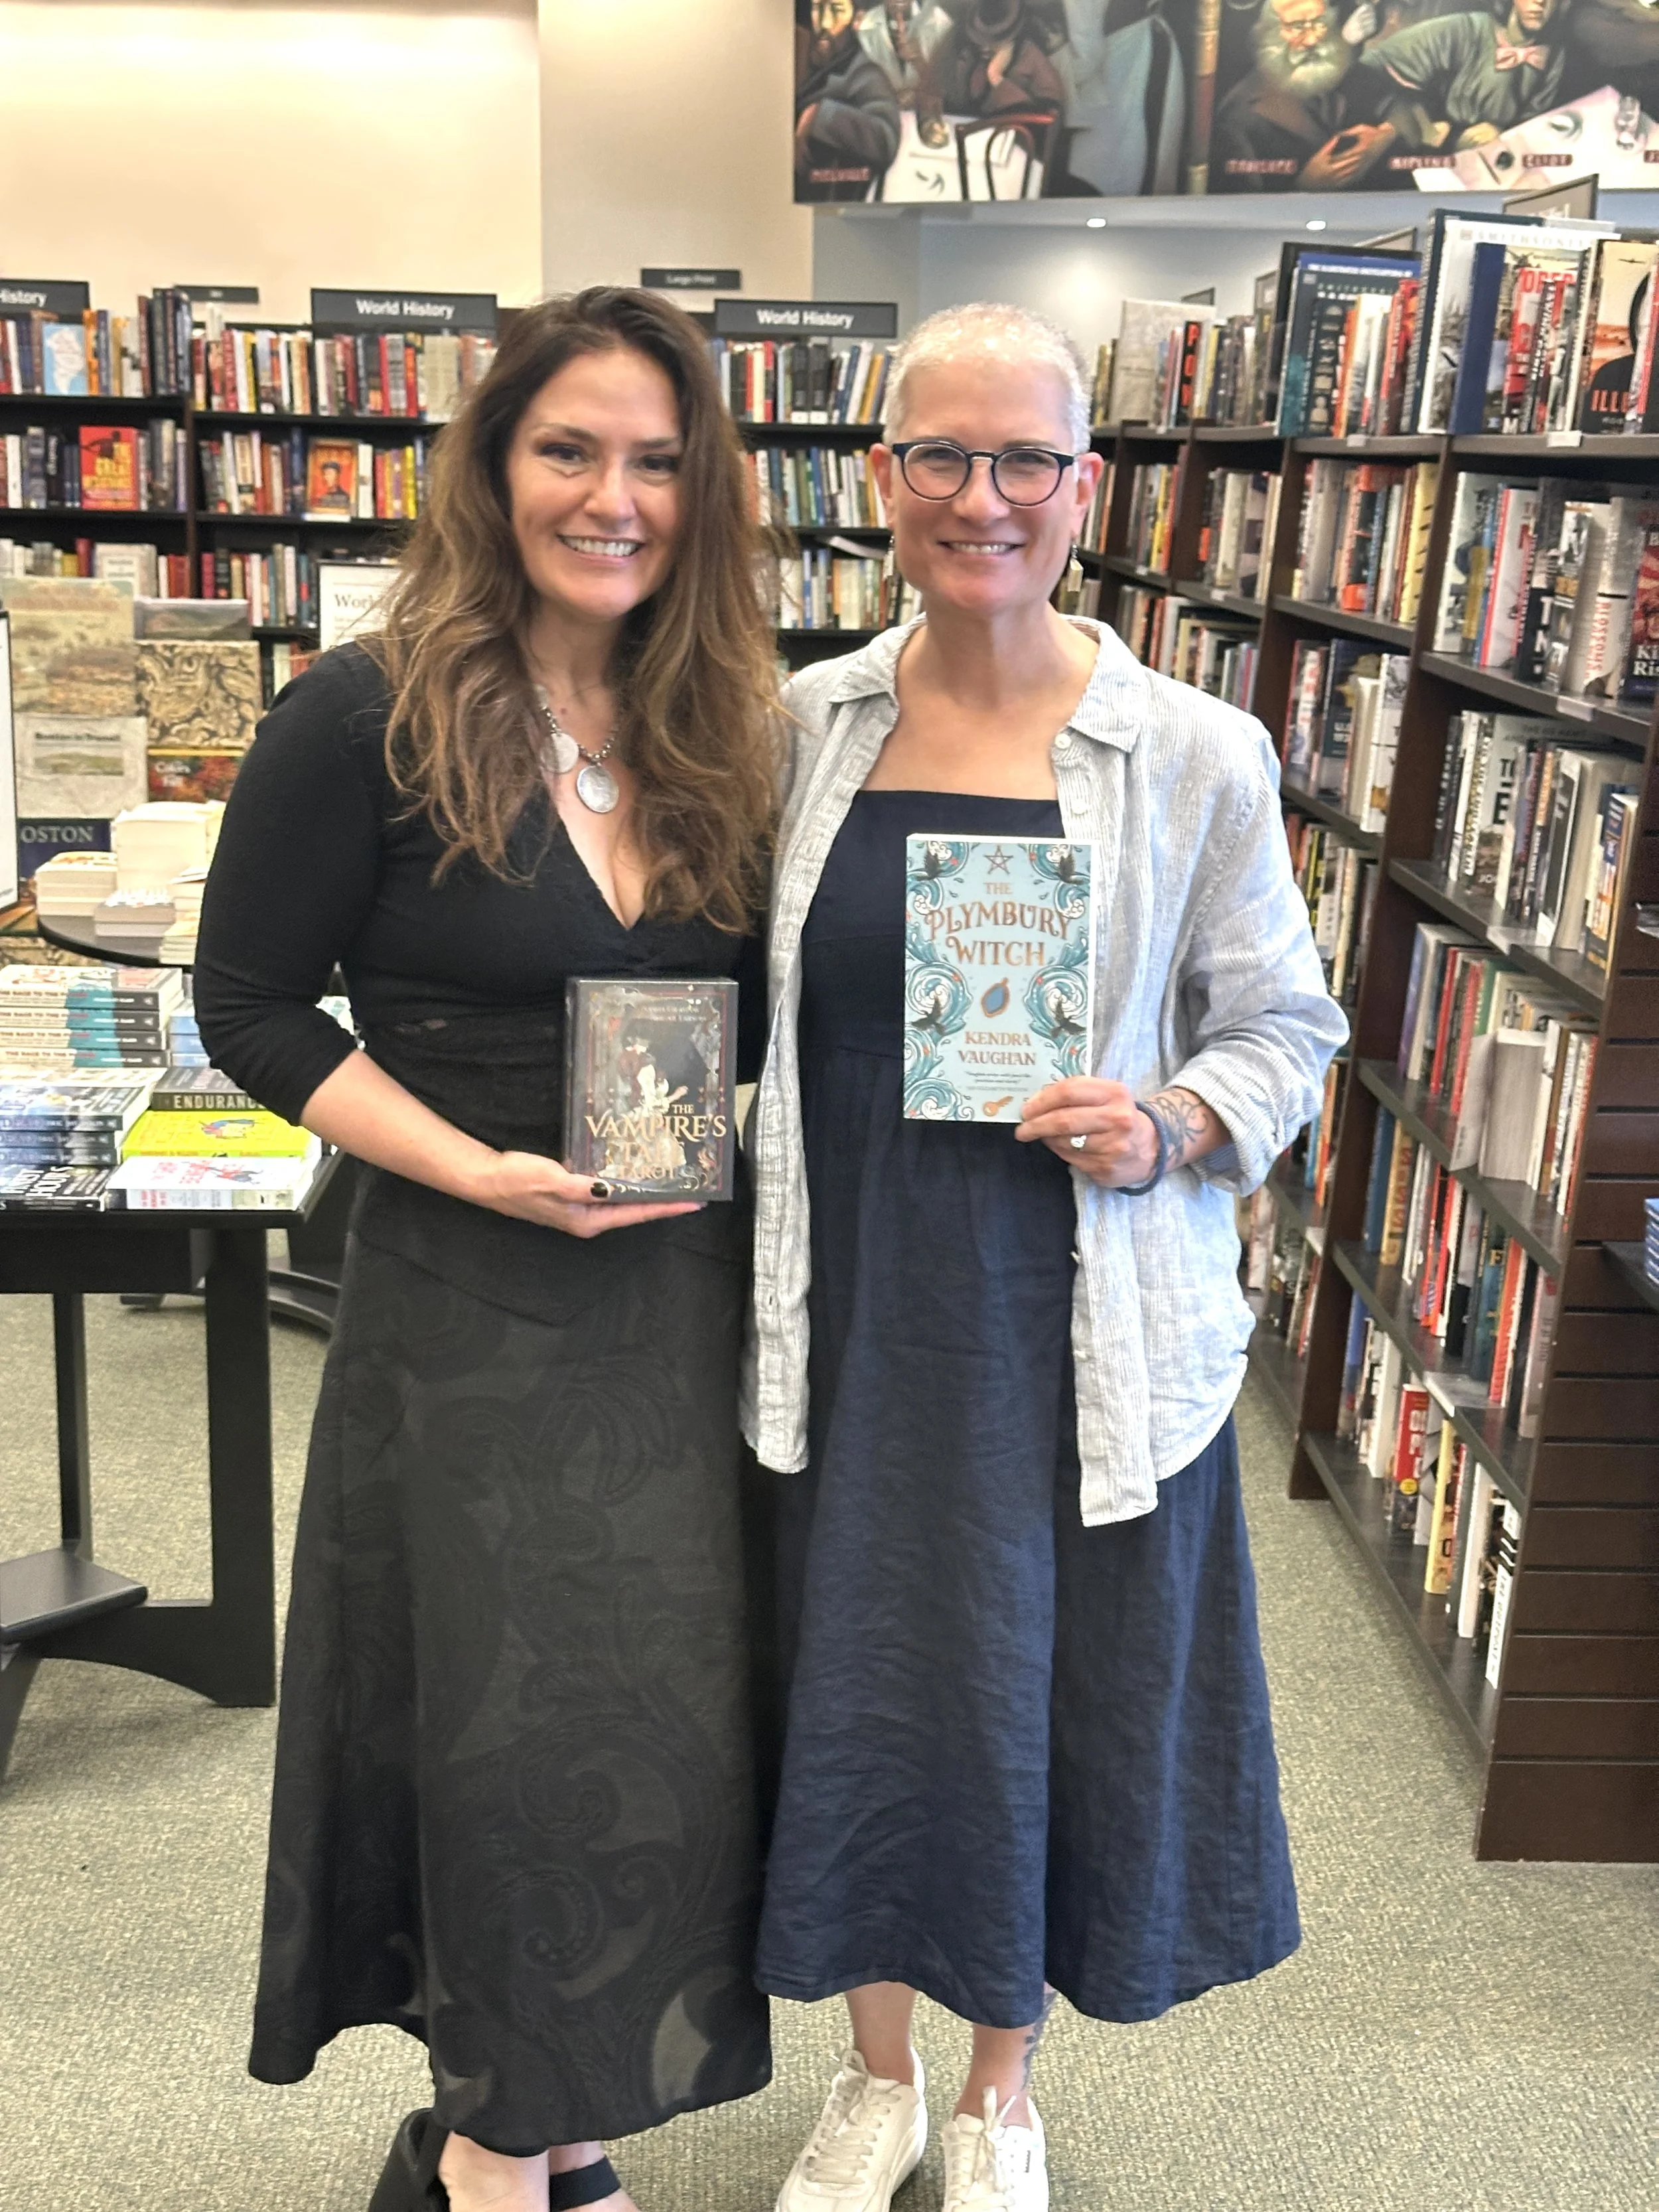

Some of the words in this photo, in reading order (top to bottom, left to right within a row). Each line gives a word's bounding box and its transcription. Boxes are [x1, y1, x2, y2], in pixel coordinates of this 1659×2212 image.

[356, 299, 400, 315] World
[402, 300, 455, 320] History
[756, 309, 800, 325] World
[802, 311, 855, 330] History
[334, 593, 377, 609] Worl
[20, 825, 94, 843] OSTON
[983, 882, 1012, 895] THE
[924, 899, 1072, 941] PLYMBURY
[945, 936, 1046, 967] WITCH
[964, 1031, 1032, 1047] KENDRA
[958, 1050, 1037, 1066] VAUGHAN
[672, 1104, 695, 1114] THE
[585, 1109, 727, 1142] VAMPIRE'S
[25, 1165, 74, 1197] HOURS
